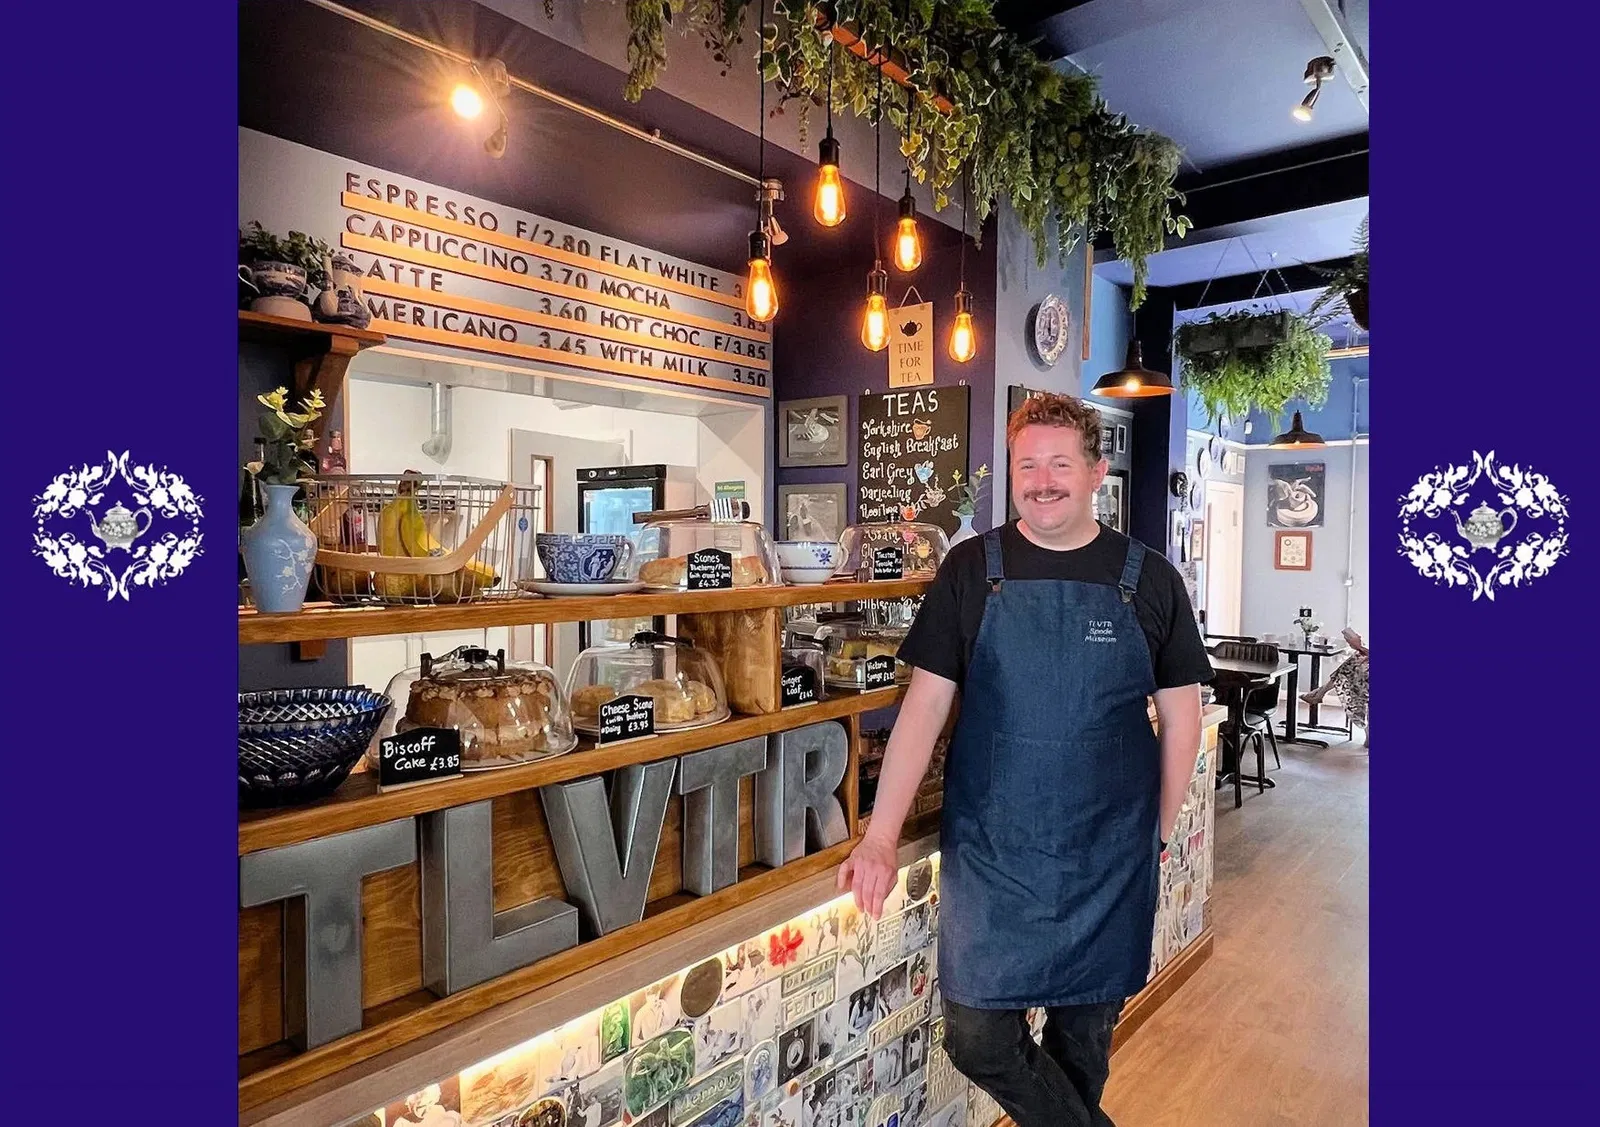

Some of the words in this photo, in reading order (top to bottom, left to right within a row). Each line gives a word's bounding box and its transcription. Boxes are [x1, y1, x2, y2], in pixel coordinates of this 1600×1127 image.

[346, 172, 498, 232] ESPRESSO
[346, 213, 529, 275] CAPPUCCINO
[540, 263, 589, 290] 3.70
[601, 245, 652, 273] FLAT
[658, 261, 720, 293] WHITE
[366, 258, 443, 293] ATTE
[540, 297, 587, 322] 3.60
[600, 278, 671, 310] MOCHA
[367, 298, 518, 343] MERICANO
[539, 332, 587, 356] 3.45
[601, 310, 643, 336] HOT
[650, 322, 705, 348] CHOC.
[714, 336, 766, 361] F/3.85
[898, 340, 924, 354] TIME
[600, 343, 653, 367] WITH
[662, 356, 708, 377] MILK
[733, 368, 766, 387] 3.50
[900, 357, 921, 369] FOR
[900, 372, 922, 383] TEA
[882, 390, 939, 417] TEAS
[862, 418, 912, 439] Yorkshire
[863, 440, 902, 461] English
[906, 433, 959, 457] Breakfast
[862, 461, 884, 480] Earl
[887, 463, 915, 485] Grey
[860, 485, 912, 503] Darjeeling
[694, 553, 720, 563] Scones
[781, 675, 803, 687] Ginger
[786, 684, 802, 695] Loaf
[601, 703, 631, 717] Cheese
[633, 698, 653, 711] Scone
[628, 720, 649, 732] £3.95
[383, 735, 436, 759] Biscoff
[394, 757, 426, 771] Cake
[429, 754, 460, 771] £3.85
[239, 720, 851, 1050] TLVTR
